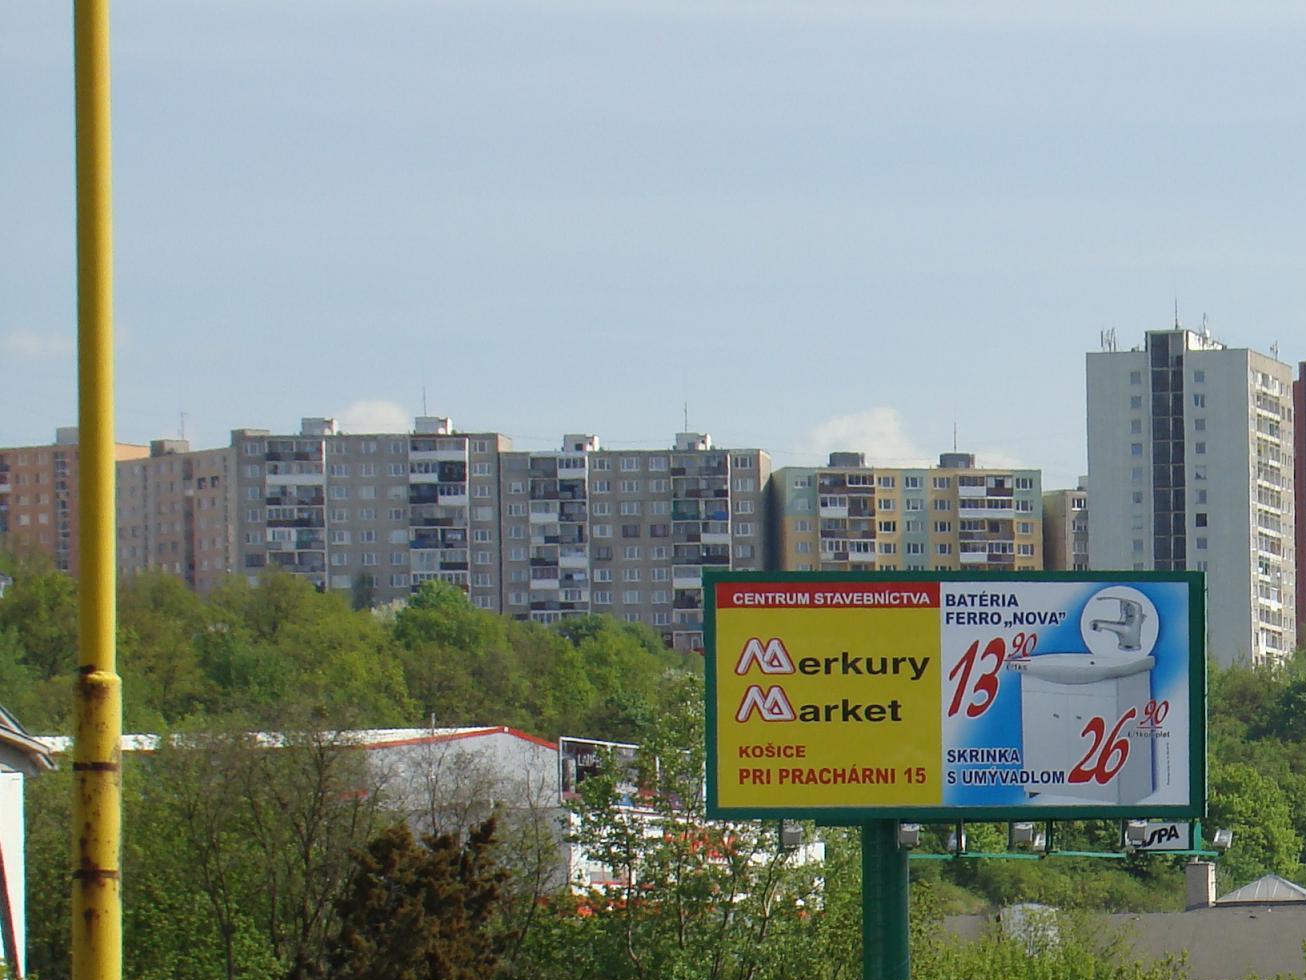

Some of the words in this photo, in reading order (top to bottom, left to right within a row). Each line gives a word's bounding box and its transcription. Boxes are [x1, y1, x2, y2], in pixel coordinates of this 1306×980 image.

[733, 593, 810, 605] CENTRUM
[814, 591, 930, 605] STAVEBNÍCTVA
[945, 590, 1019, 607] BATÉRIA
[946, 612, 1001, 625] FERRO
[734, 637, 930, 681] Merkury
[948, 637, 1006, 718] 13
[1008, 632, 1037, 659] 90
[735, 684, 902, 723] Market
[738, 742, 806, 758] KOŠICE
[1068, 707, 1137, 785] 26
[1140, 700, 1169, 726] 90
[947, 749, 1020, 763] SKRINKA
[738, 768, 771, 785] PRI
[778, 764, 896, 785] PRACHÁRNI
[904, 768, 927, 784] 15
[947, 771, 957, 784] S
[962, 767, 1065, 785] UMÝVADLOM
